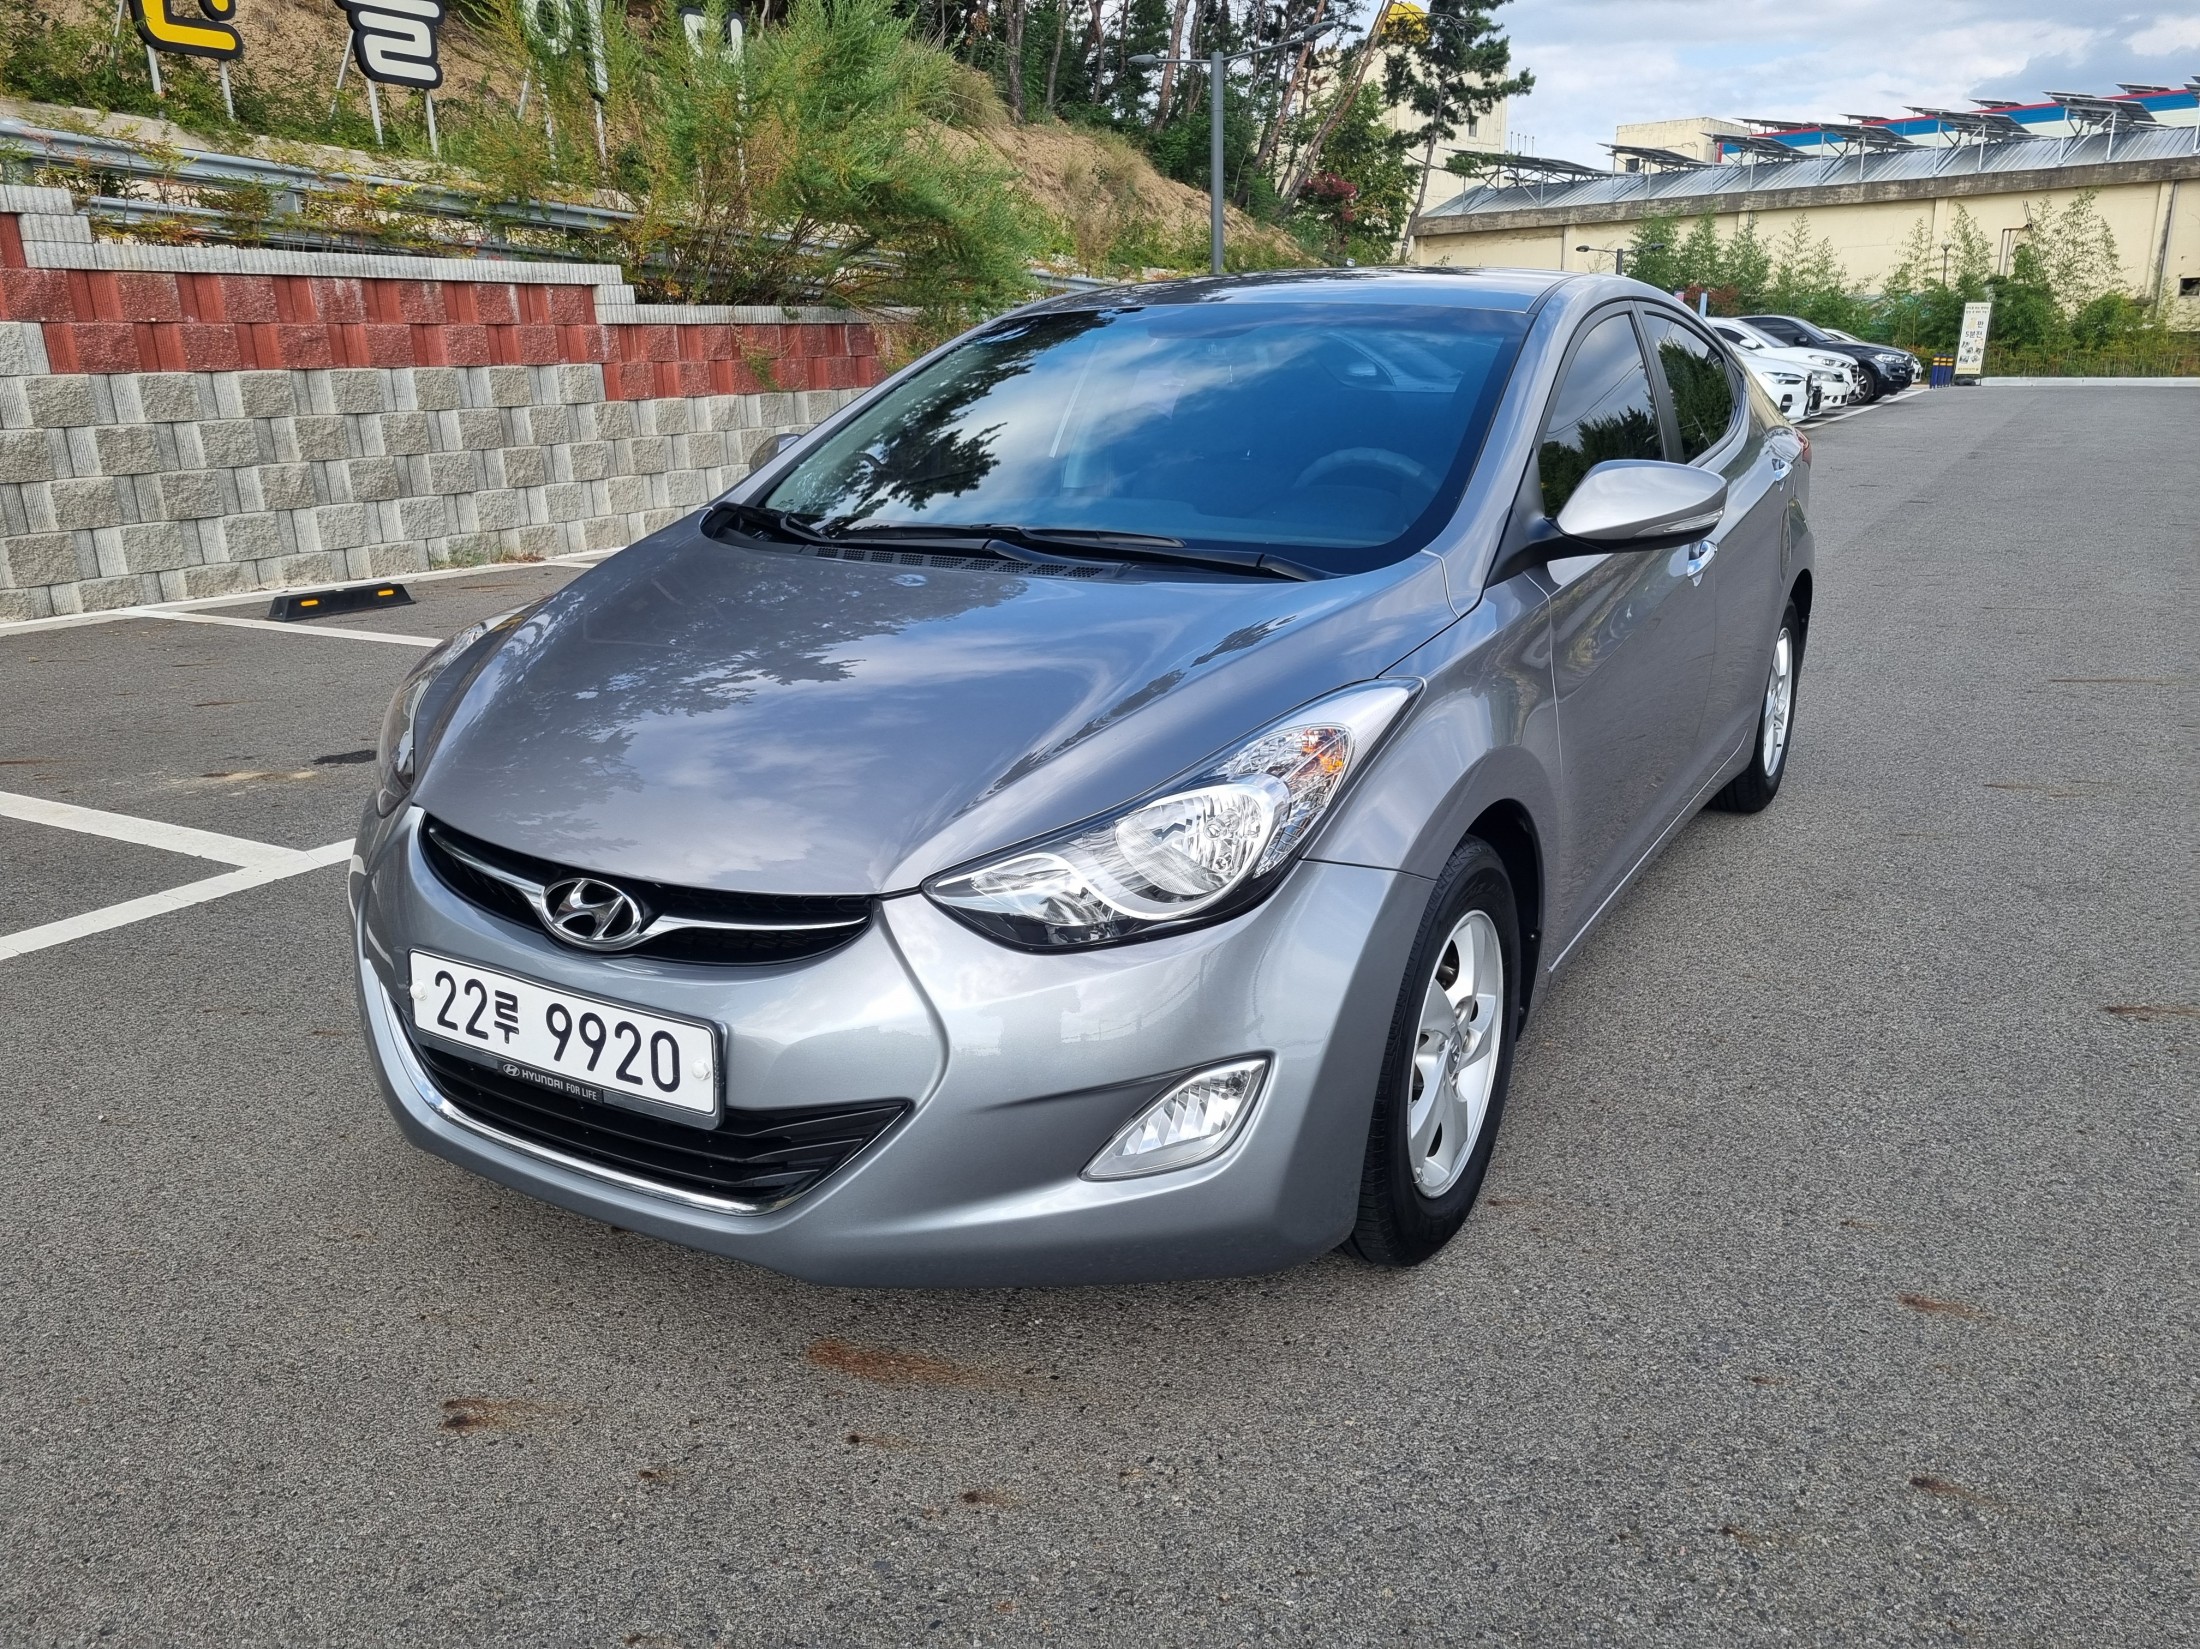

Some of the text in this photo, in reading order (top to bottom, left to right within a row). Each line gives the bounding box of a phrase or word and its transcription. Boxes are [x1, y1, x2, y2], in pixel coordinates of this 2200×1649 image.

[435, 971, 681, 1093] 22루 9920
[522, 1069, 597, 1101] HYUNDAI FOR LIFE
